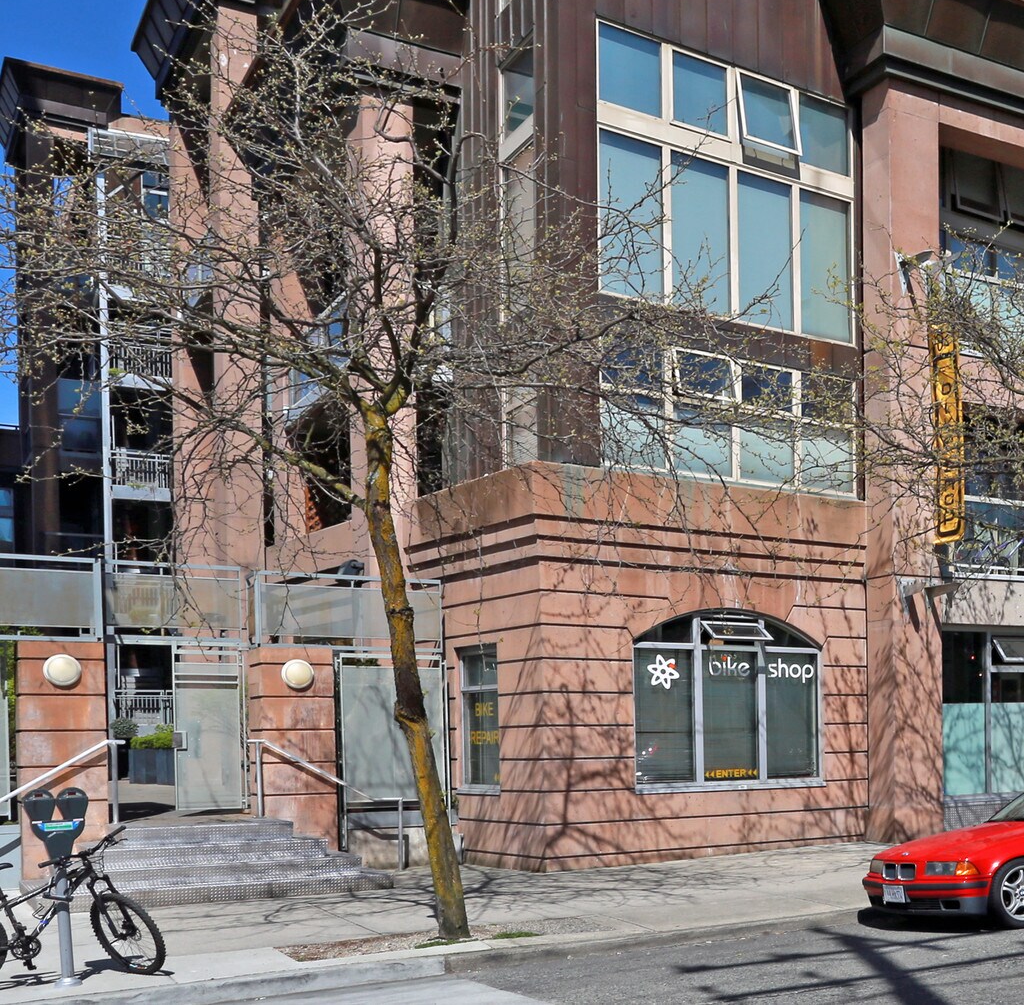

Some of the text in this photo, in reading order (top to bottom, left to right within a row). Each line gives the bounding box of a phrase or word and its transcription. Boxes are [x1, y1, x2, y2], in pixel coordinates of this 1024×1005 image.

[708, 655, 814, 683] bike shop
[475, 702, 493, 716] BIKE
[471, 730, 499, 744] REPAIR
[716, 769, 746, 778] ENTER
